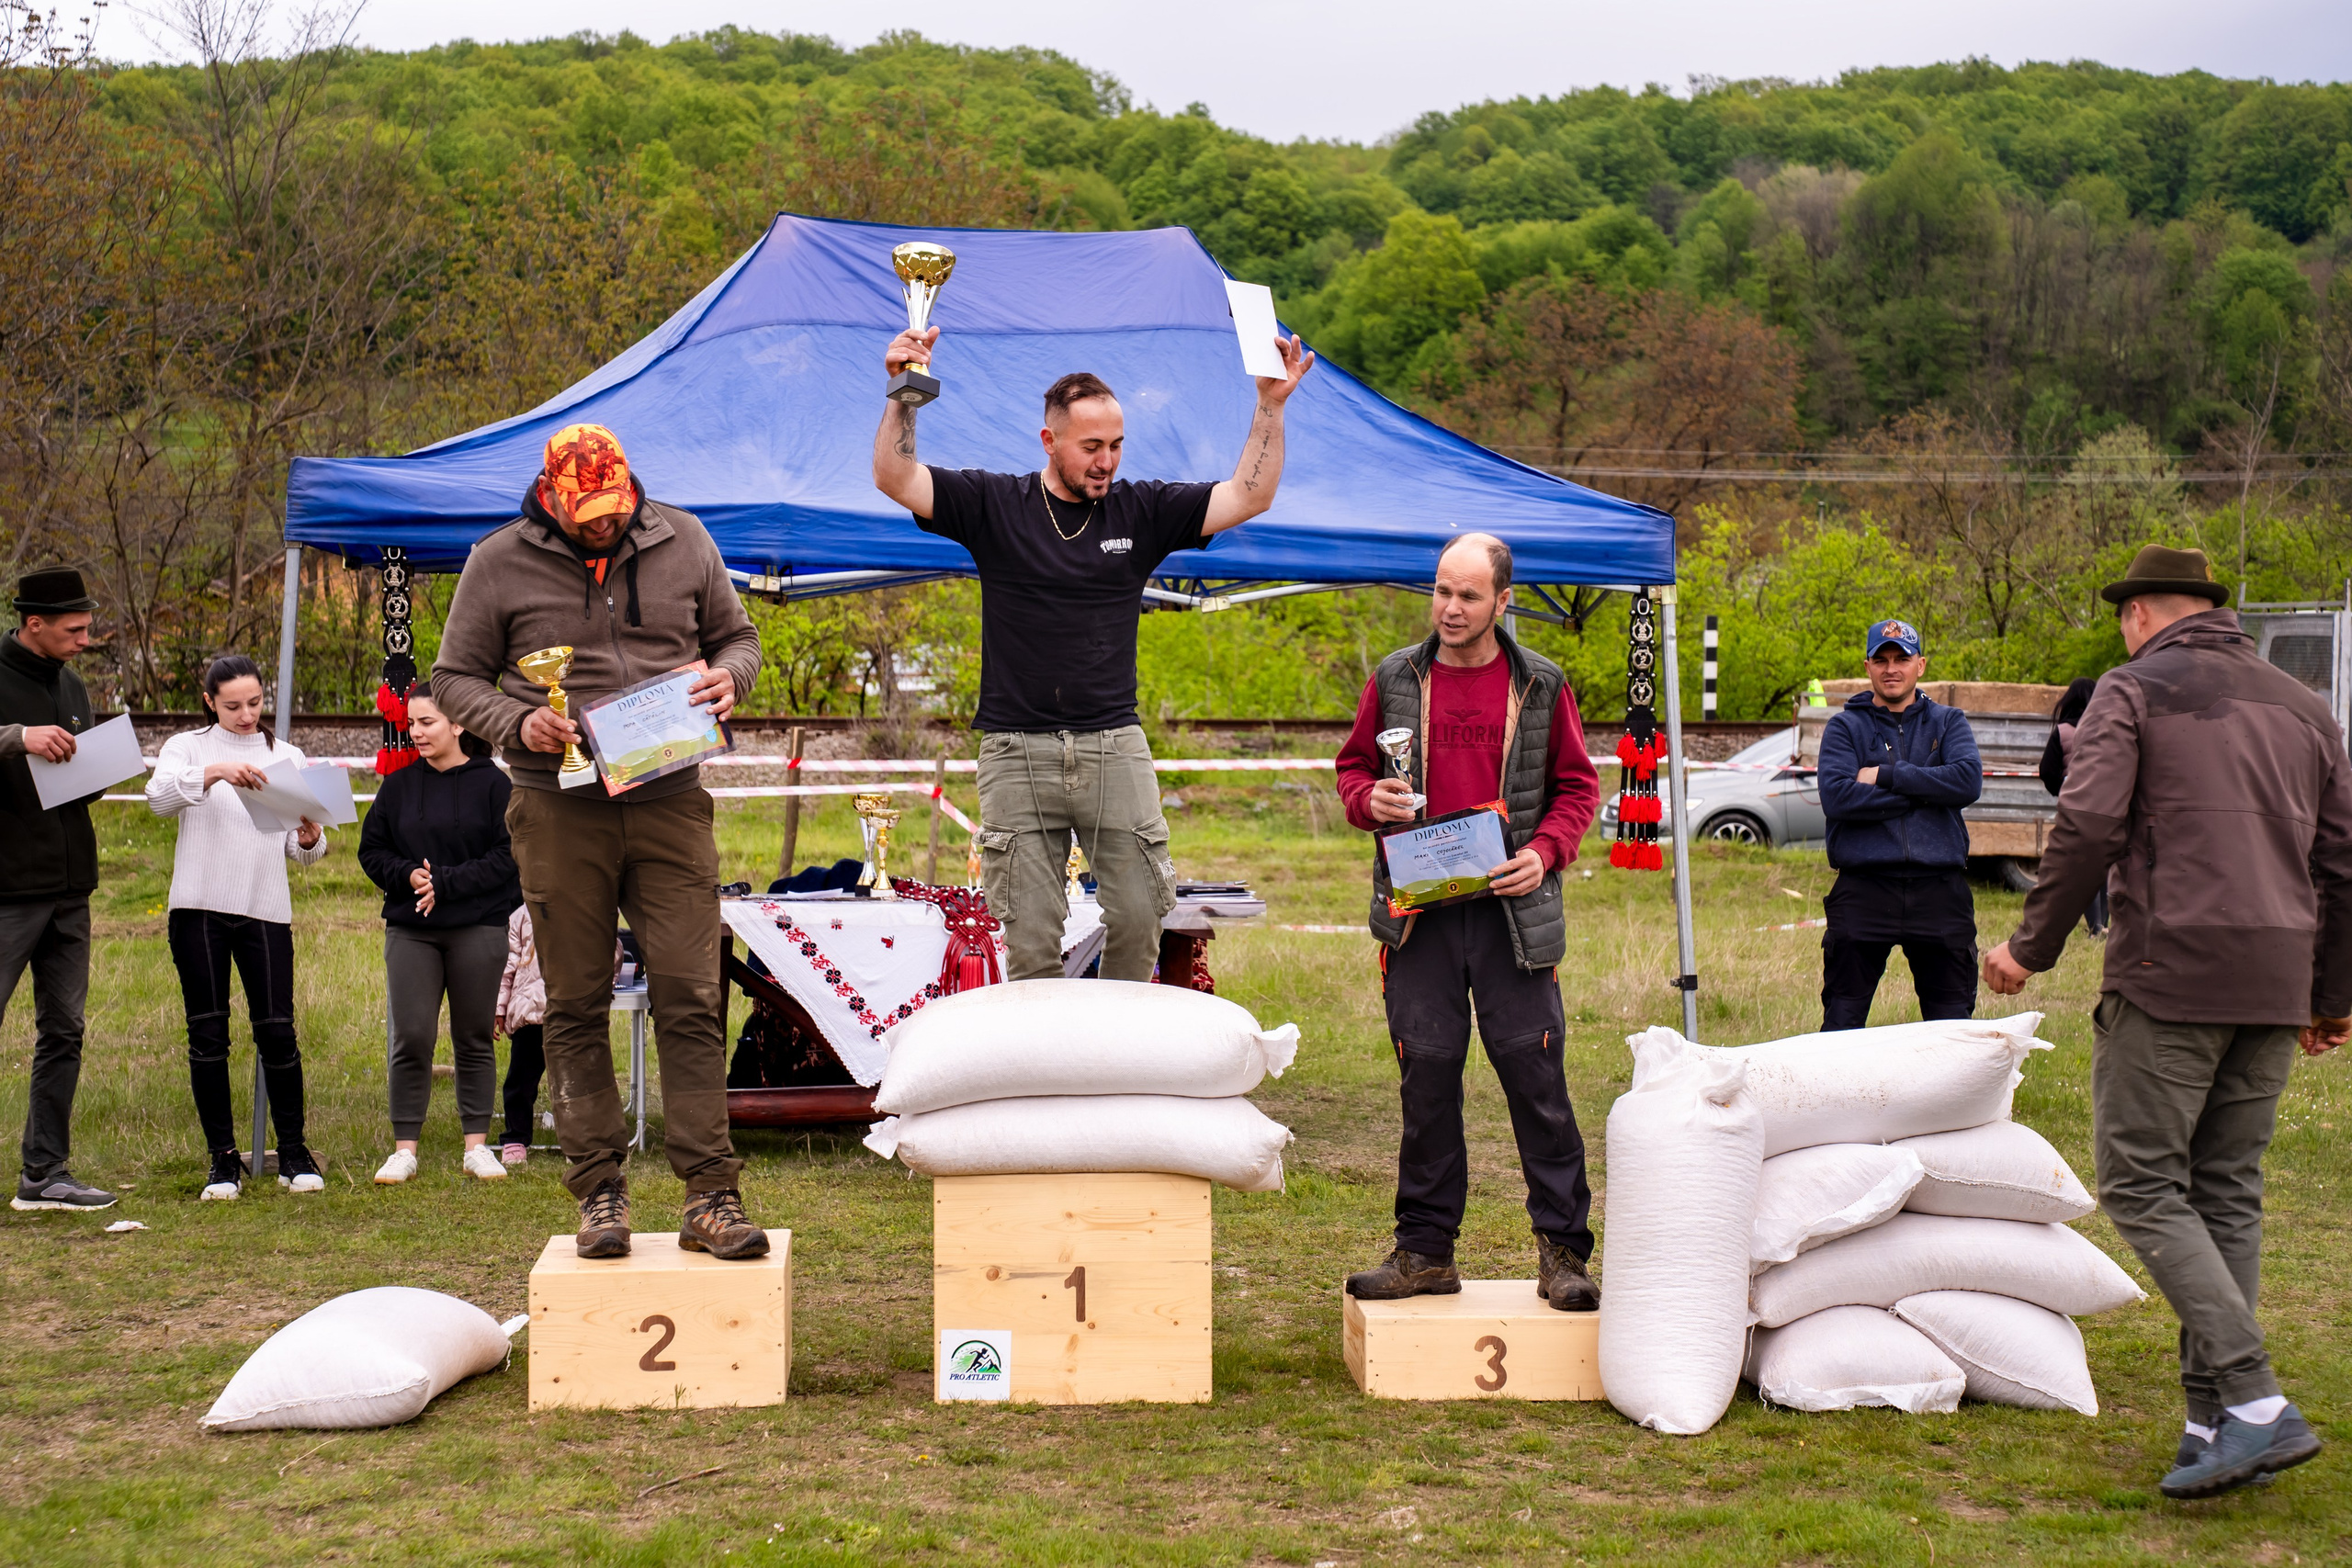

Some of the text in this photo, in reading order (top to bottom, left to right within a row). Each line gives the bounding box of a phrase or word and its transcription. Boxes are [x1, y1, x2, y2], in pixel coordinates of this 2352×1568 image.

[1100, 538, 1133, 553] TOMORRO
[1433, 724, 1506, 744] LIFORNI
[1414, 818, 1471, 841] DIPLOMĂ
[1064, 1266, 1086, 1323] 1
[639, 1314, 676, 1371] 2
[1474, 1335, 1508, 1392] 3
